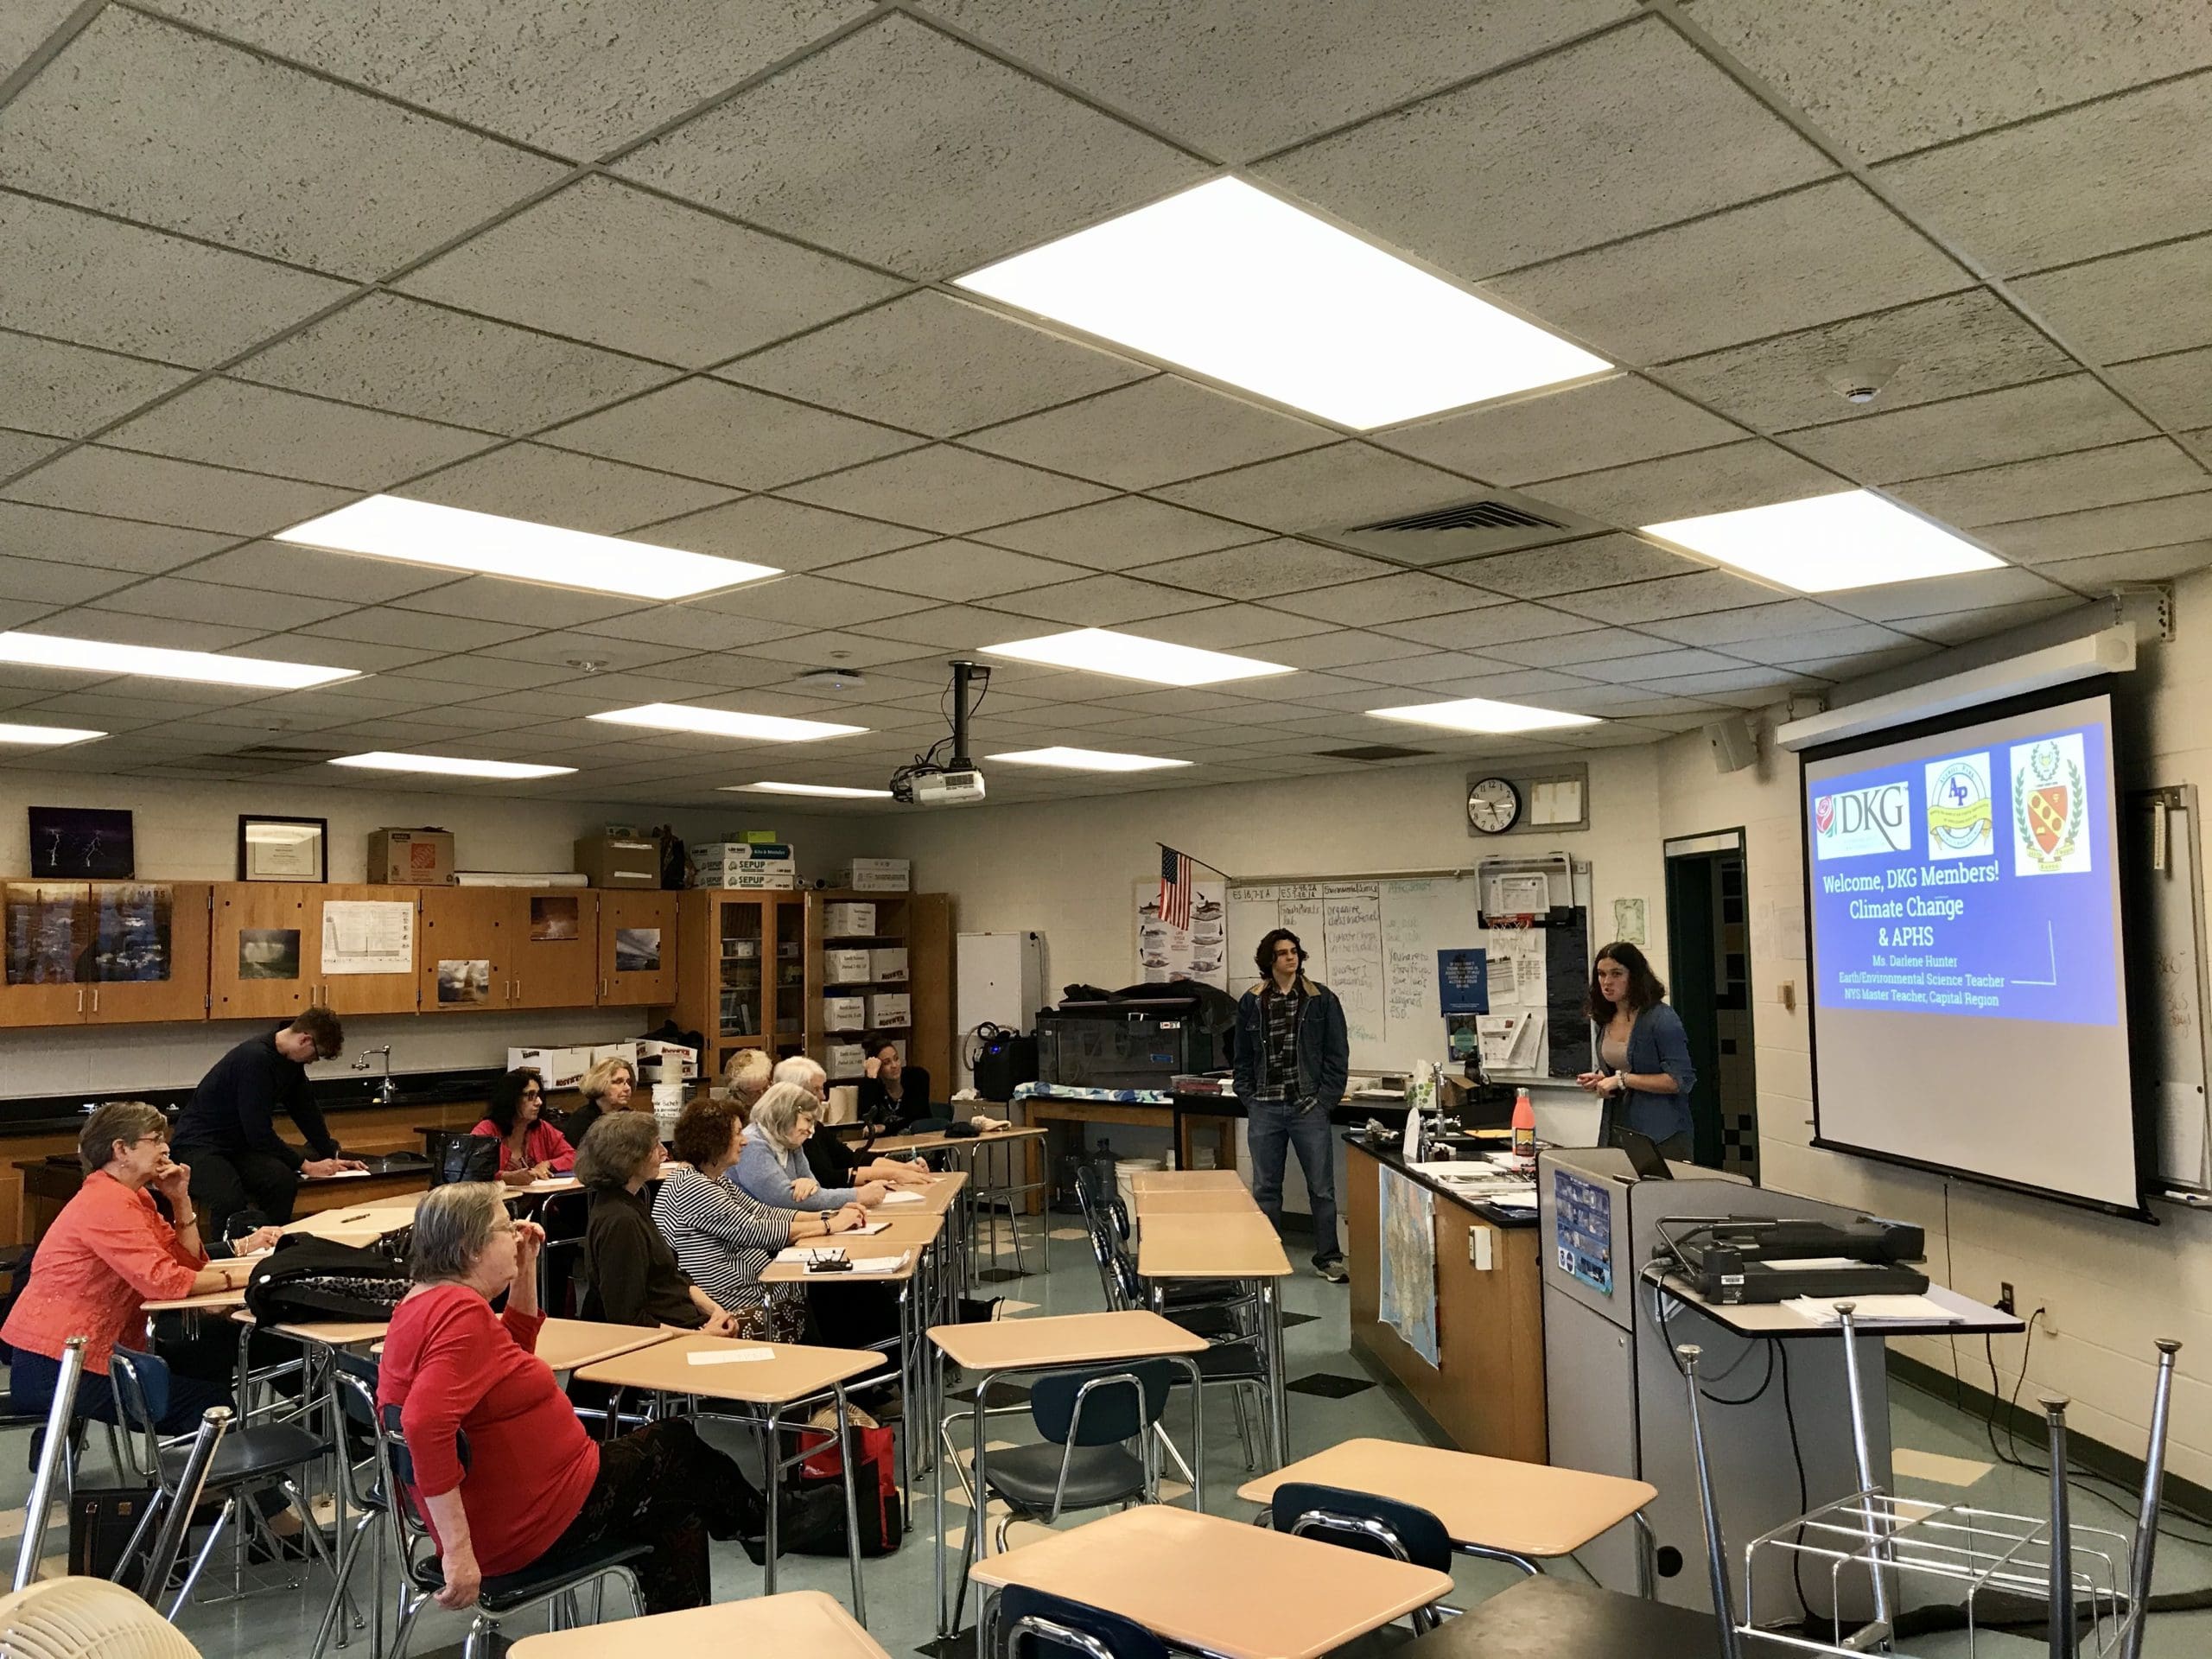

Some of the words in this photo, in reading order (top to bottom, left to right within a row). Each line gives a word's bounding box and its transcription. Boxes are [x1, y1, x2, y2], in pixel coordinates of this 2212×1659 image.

[1840, 785, 1904, 851] DKG
[1822, 873, 1885, 893] Welcome,
[1886, 868, 1917, 888] DKG
[1920, 860, 1999, 887] Members!
[138, 890, 166, 899] MARS
[1849, 899, 1904, 918] Climate
[1906, 895, 1963, 921] Change
[1878, 927, 1889, 946] &
[1891, 925, 1934, 946] APHS
[1890, 954, 1923, 967] Darlene
[1925, 955, 1958, 968] Hunter
[1839, 970, 1924, 985] Earth/Environmental
[1926, 973, 1963, 986] Science
[1965, 974, 2005, 988] Teacher
[1845, 988, 1861, 1000] NYS
[1862, 988, 1889, 1001] Master
[1891, 989, 1929, 1004] Teacher,
[1929, 990, 1962, 1007] Capital
[1964, 992, 1999, 1009] Region
